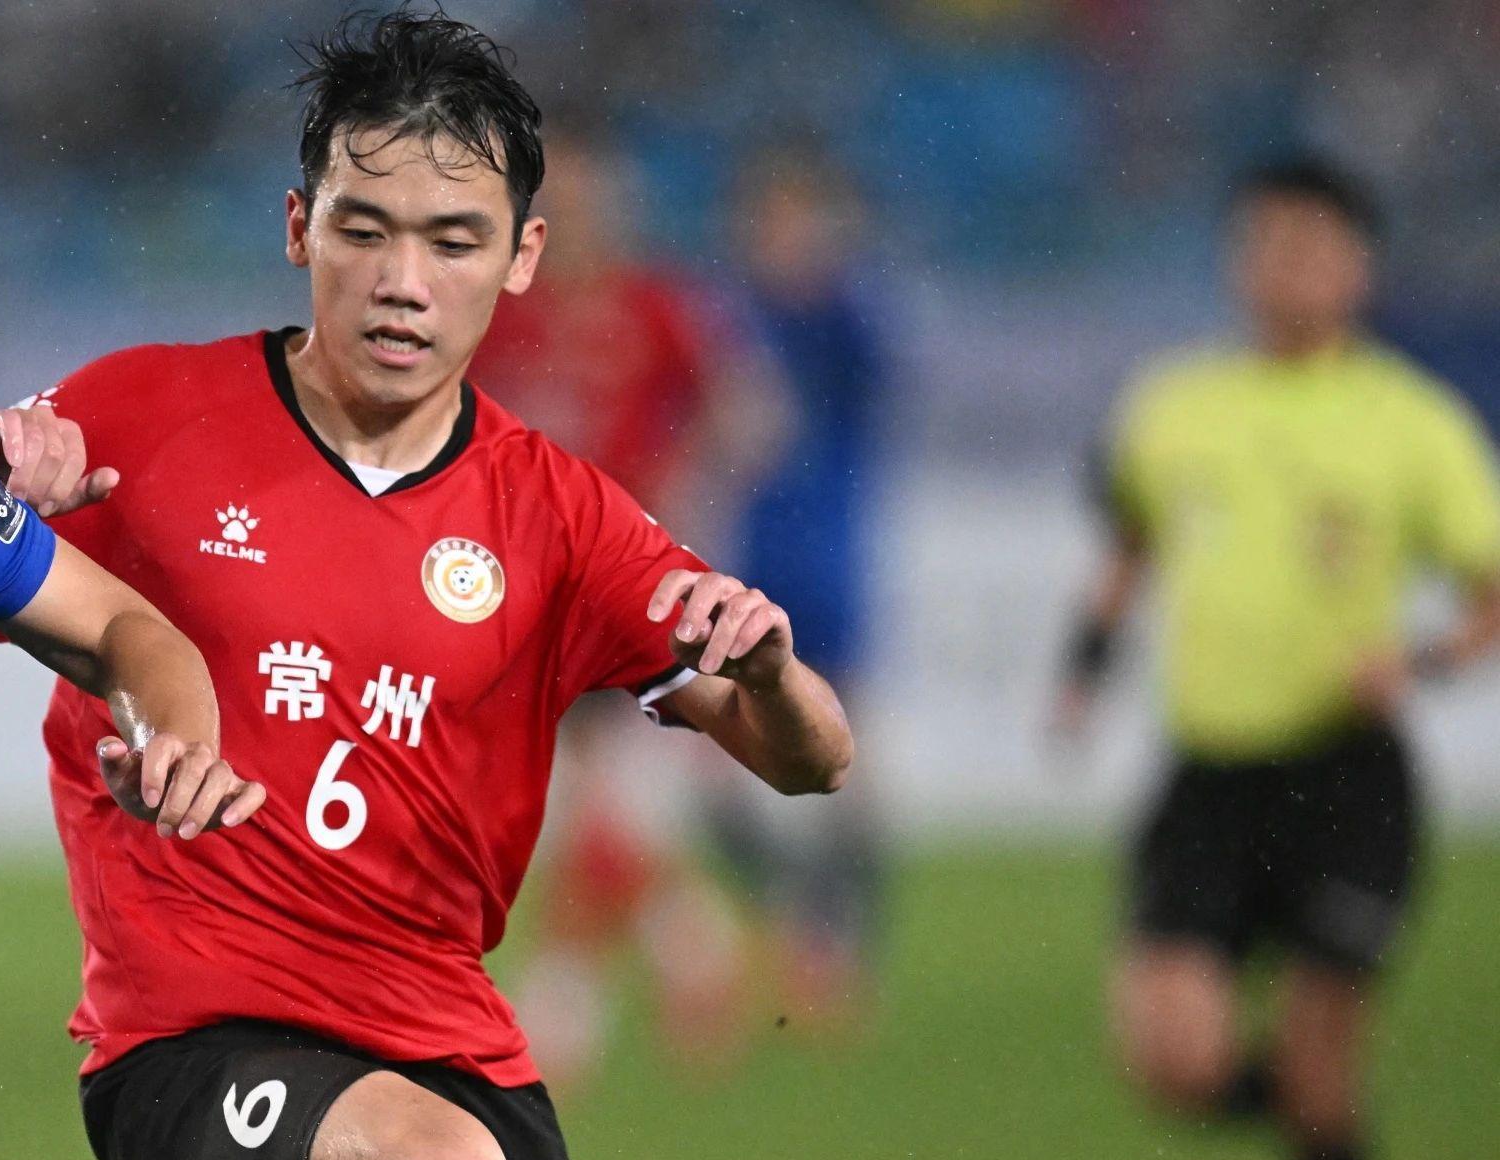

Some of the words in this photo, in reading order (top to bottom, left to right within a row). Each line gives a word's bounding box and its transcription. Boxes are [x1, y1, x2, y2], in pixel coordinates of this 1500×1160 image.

[199, 538, 267, 564] KELME
[258, 641, 436, 748] 常州
[305, 740, 368, 850] 6
[222, 1079, 287, 1149] 6
